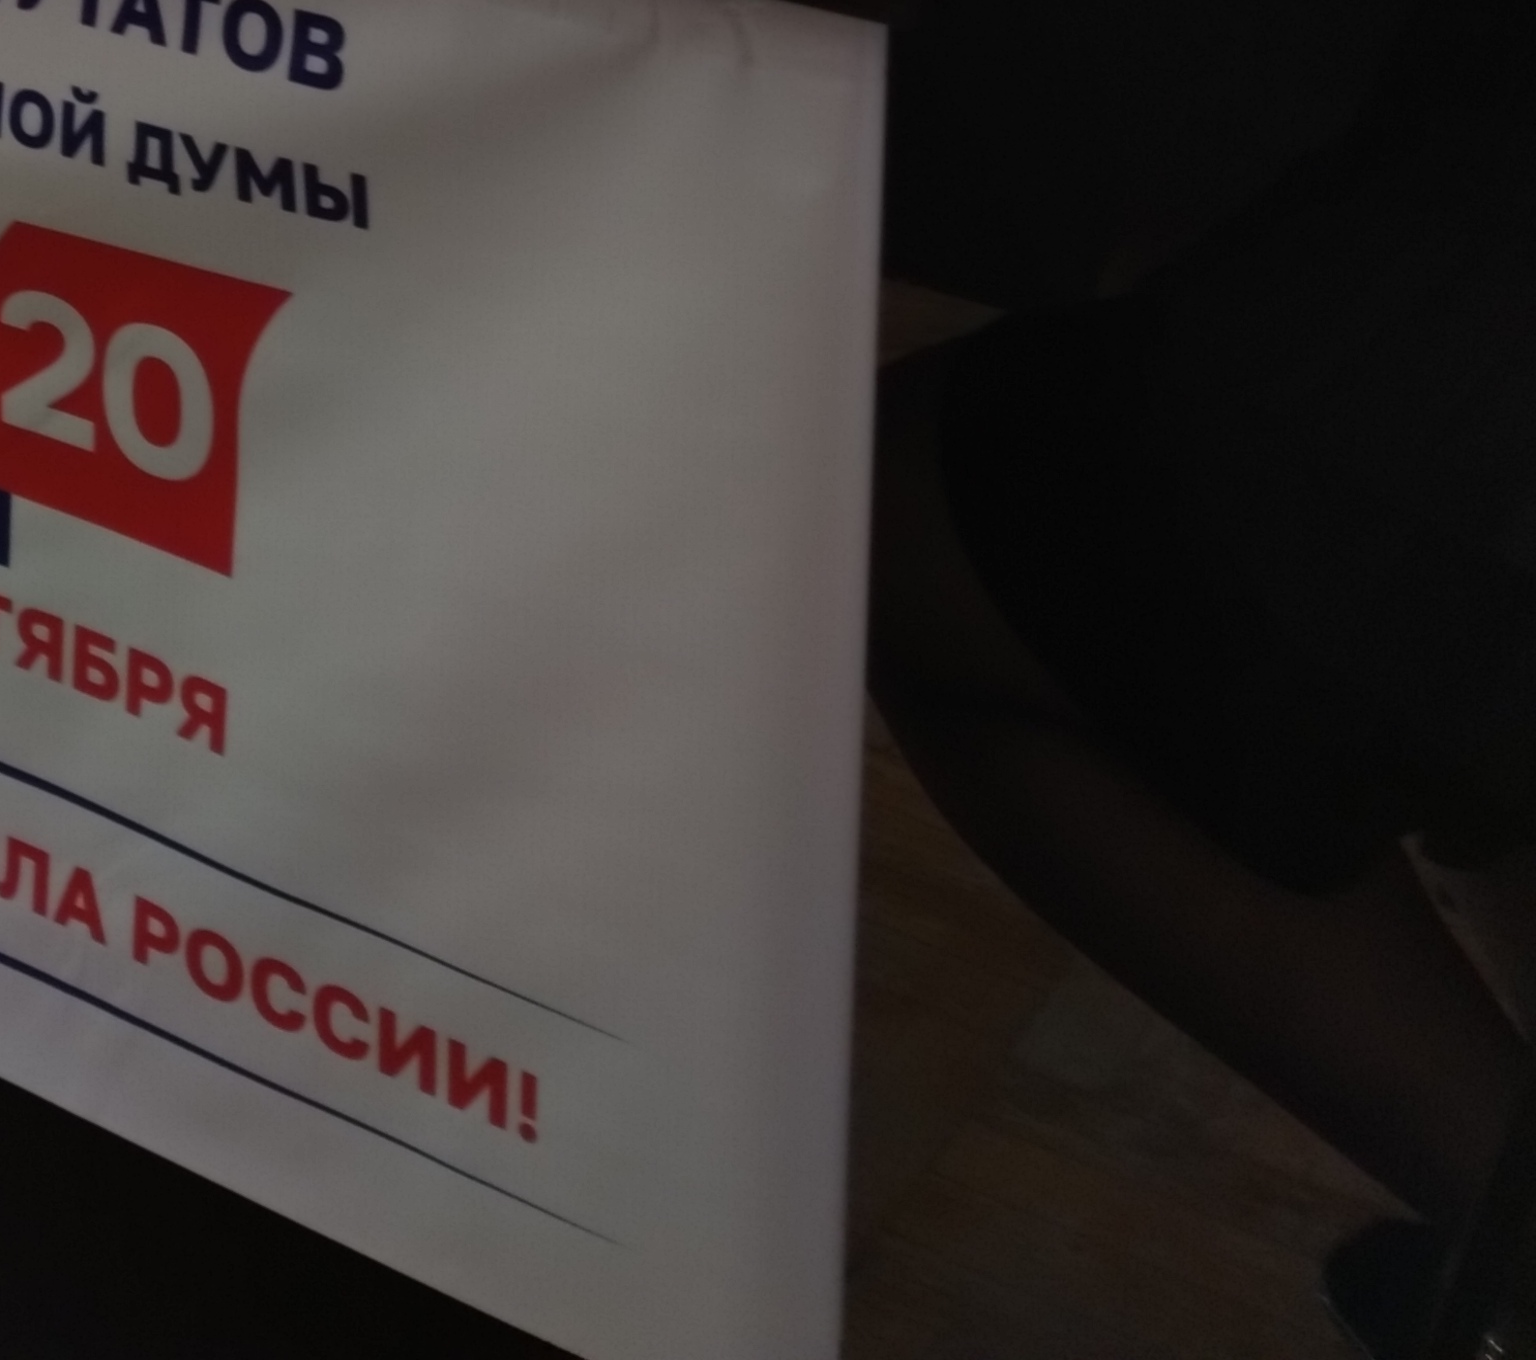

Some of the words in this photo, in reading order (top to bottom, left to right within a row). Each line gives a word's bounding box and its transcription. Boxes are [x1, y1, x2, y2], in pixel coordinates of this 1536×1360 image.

[125, 120, 370, 231] ДУМЫ
[0, 290, 214, 482] 20
[130, 895, 540, 1145] РОССИИ!
